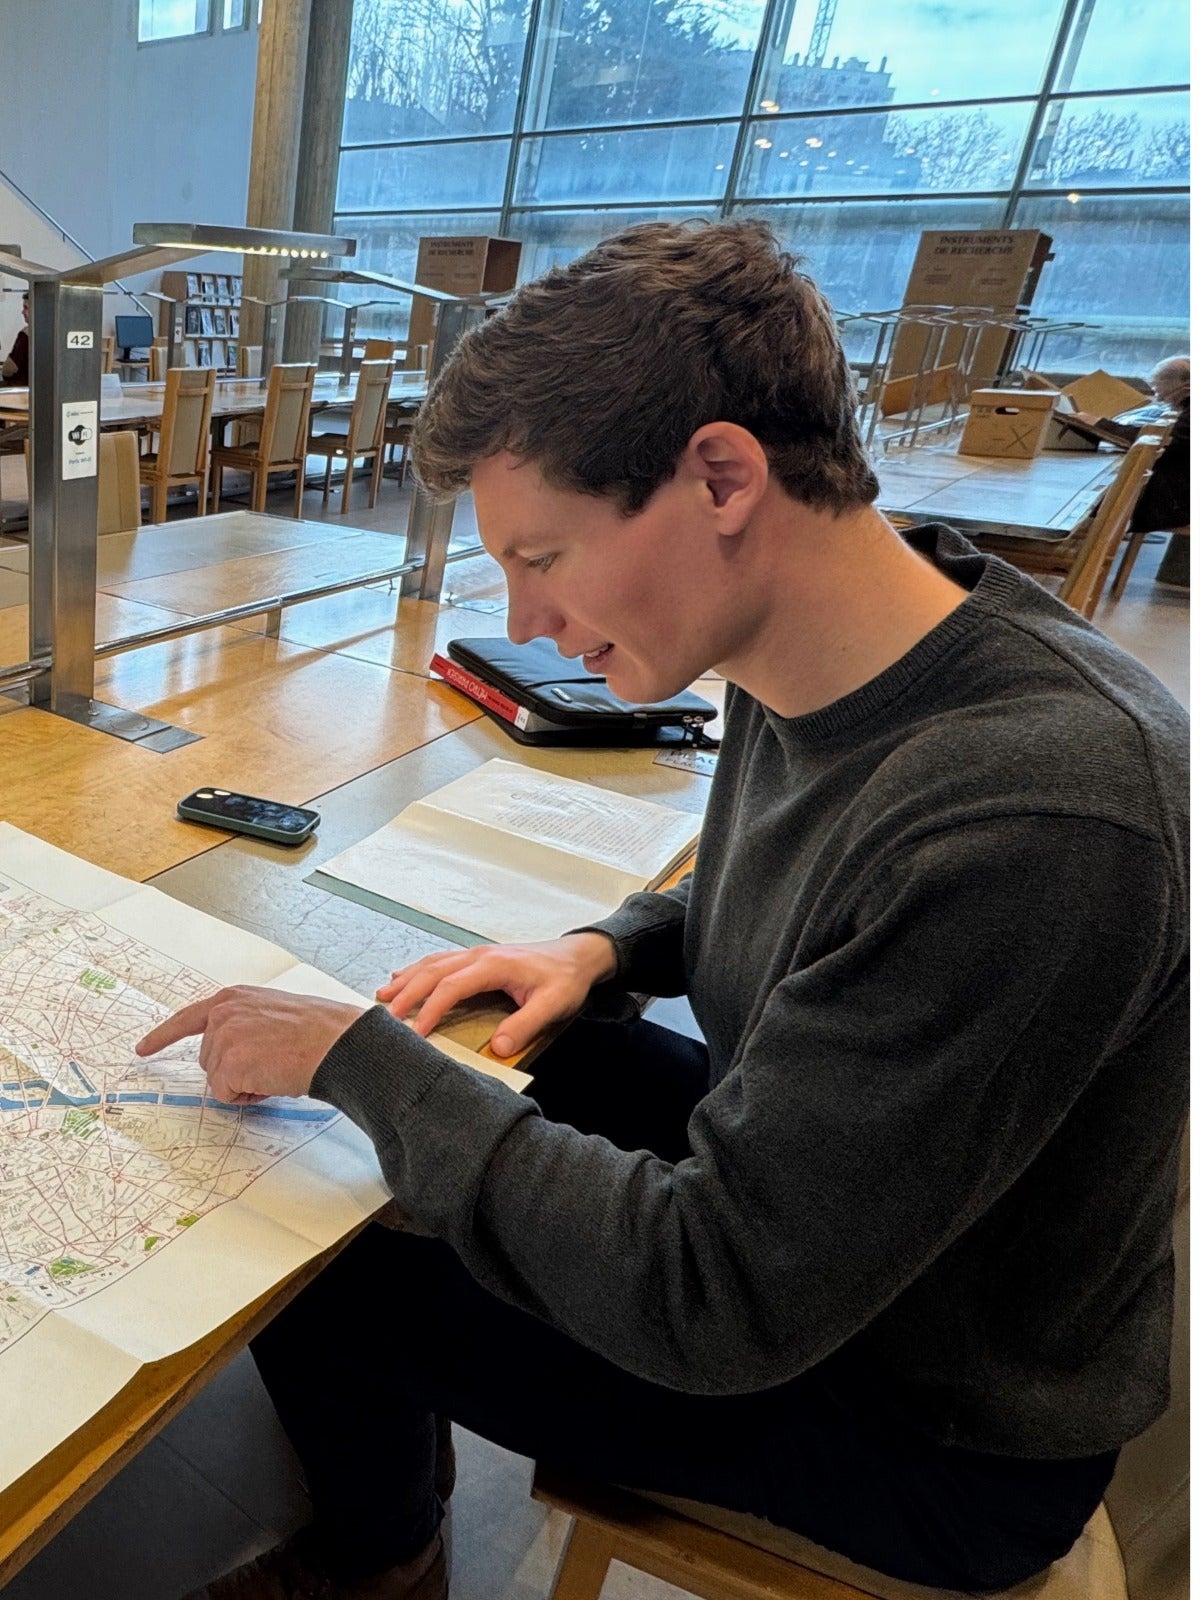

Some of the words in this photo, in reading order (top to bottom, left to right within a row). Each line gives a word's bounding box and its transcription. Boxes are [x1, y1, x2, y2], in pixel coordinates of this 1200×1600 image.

[940, 235, 1014, 244] INSTRUMENTS
[934, 246, 946, 255] DE
[950, 246, 1014, 256] RECHERCHE
[70, 335, 91, 346] 42
